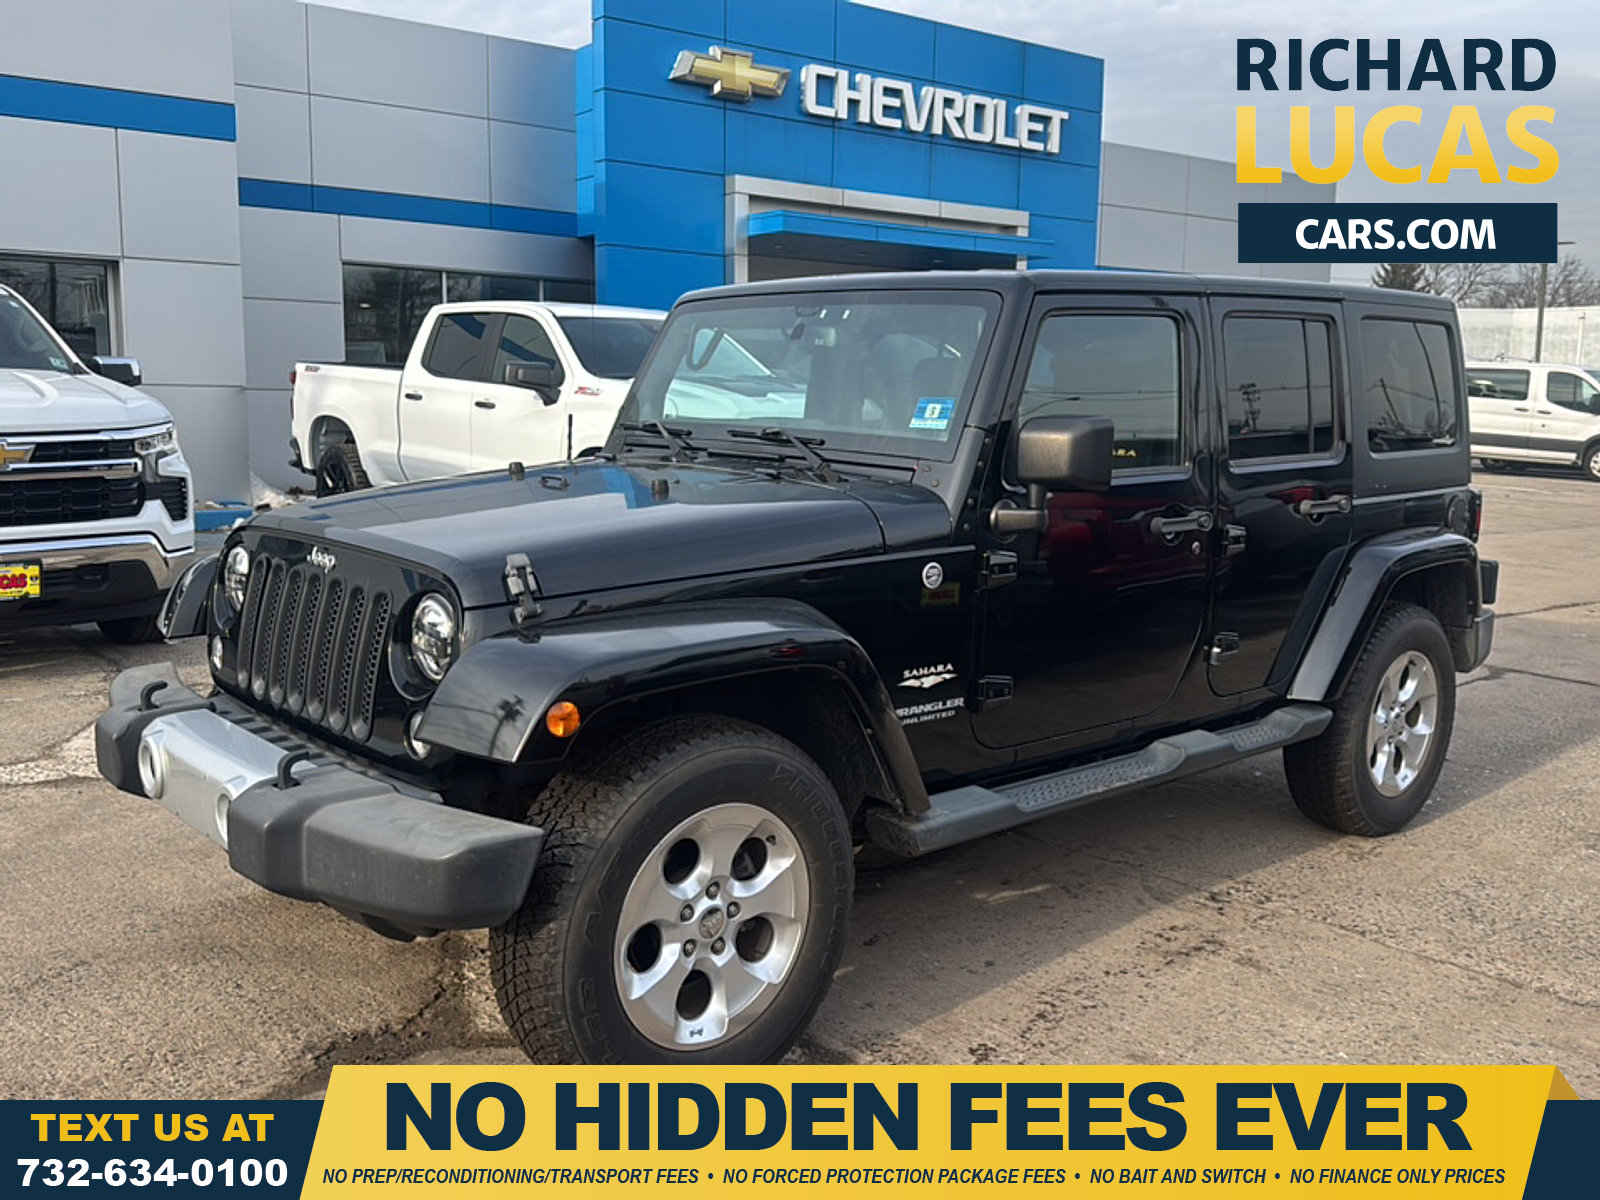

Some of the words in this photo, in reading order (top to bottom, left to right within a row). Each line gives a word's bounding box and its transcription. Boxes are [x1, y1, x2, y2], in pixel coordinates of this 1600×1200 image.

[800, 63, 1069, 154] CHEVROLET
[306, 546, 335, 574] Jeep
[903, 662, 954, 679] SAHARA
